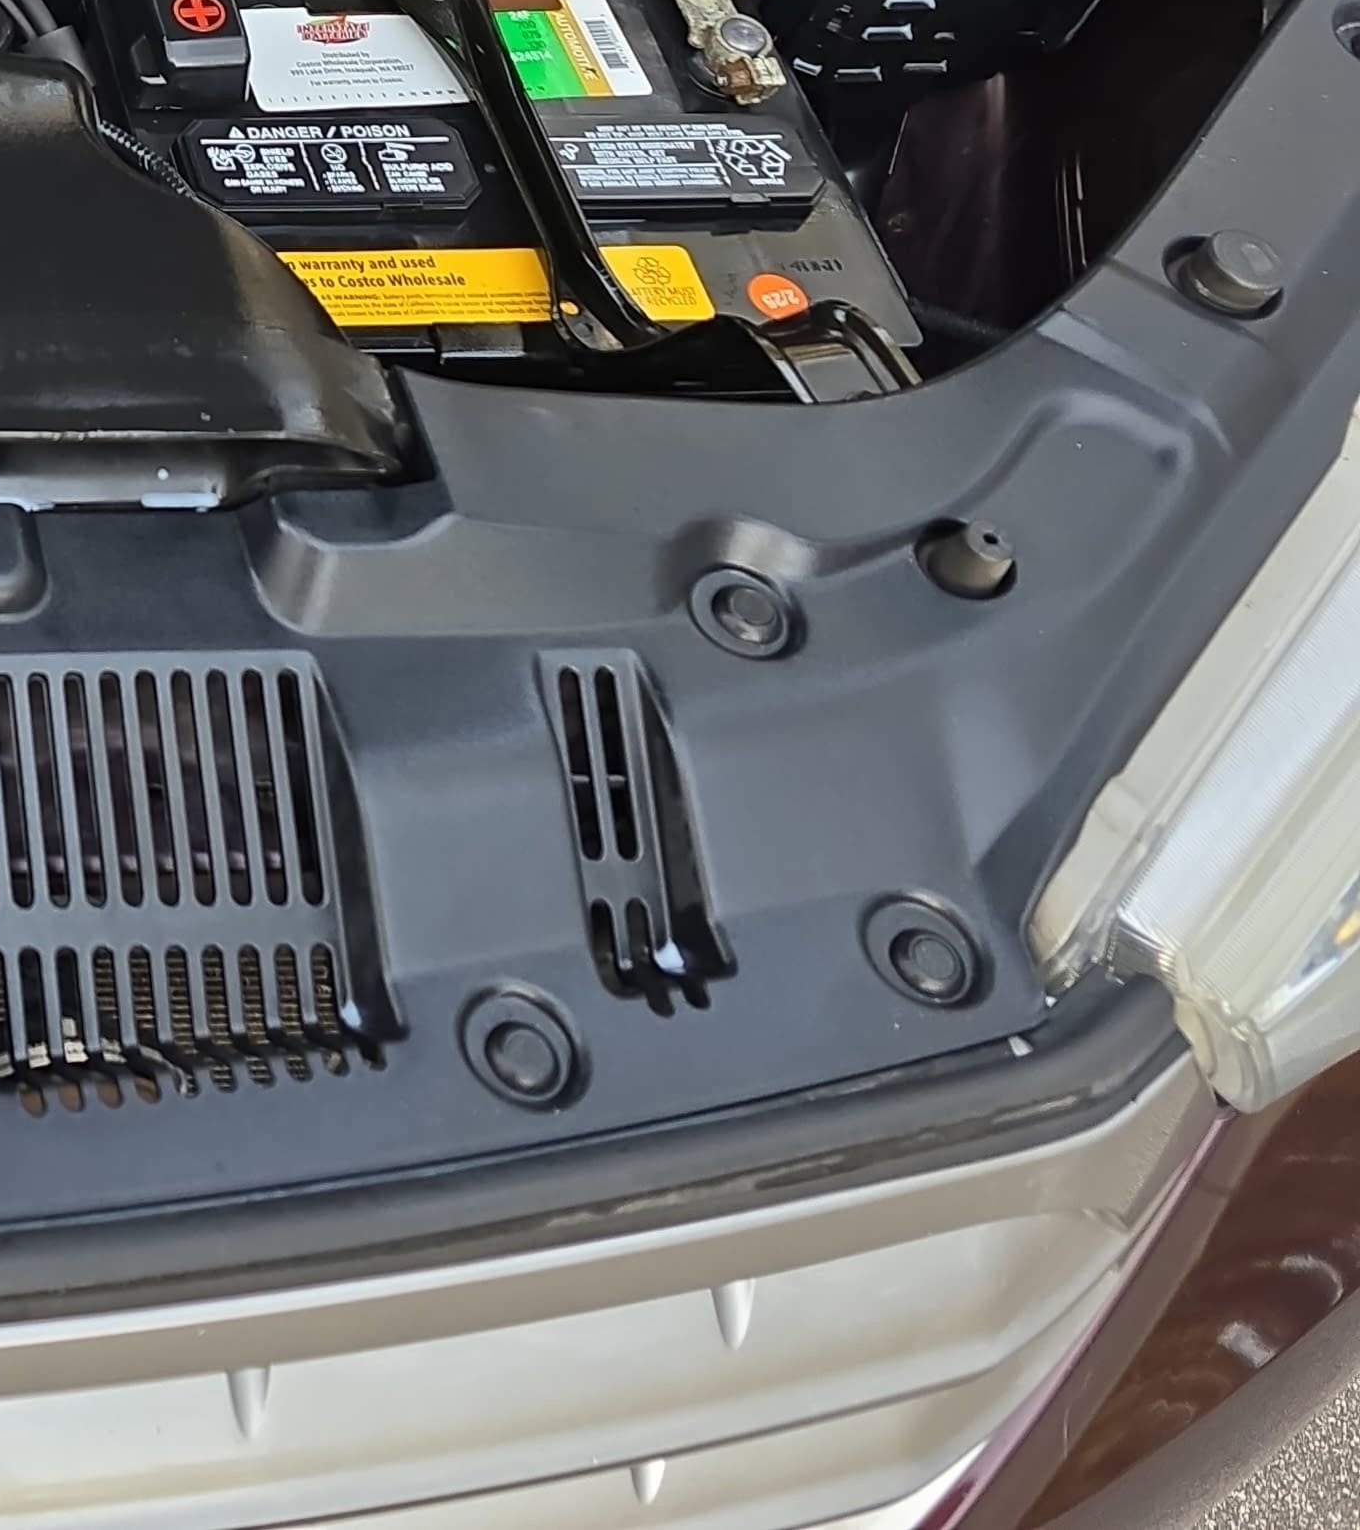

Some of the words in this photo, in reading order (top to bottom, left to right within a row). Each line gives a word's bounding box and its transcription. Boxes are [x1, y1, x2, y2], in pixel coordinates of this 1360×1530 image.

[290, 69, 305, 77] 999
[306, 68, 322, 76] Lake
[247, 127, 323, 139] DANGER
[326, 125, 337, 138] /
[341, 124, 410, 138] POISON
[299, 259, 365, 273] warranty
[369, 257, 397, 270] and
[401, 255, 437, 269] used
[320, 276, 334, 289] to
[338, 276, 386, 289] Costco
[389, 273, 466, 287] Wholesale
